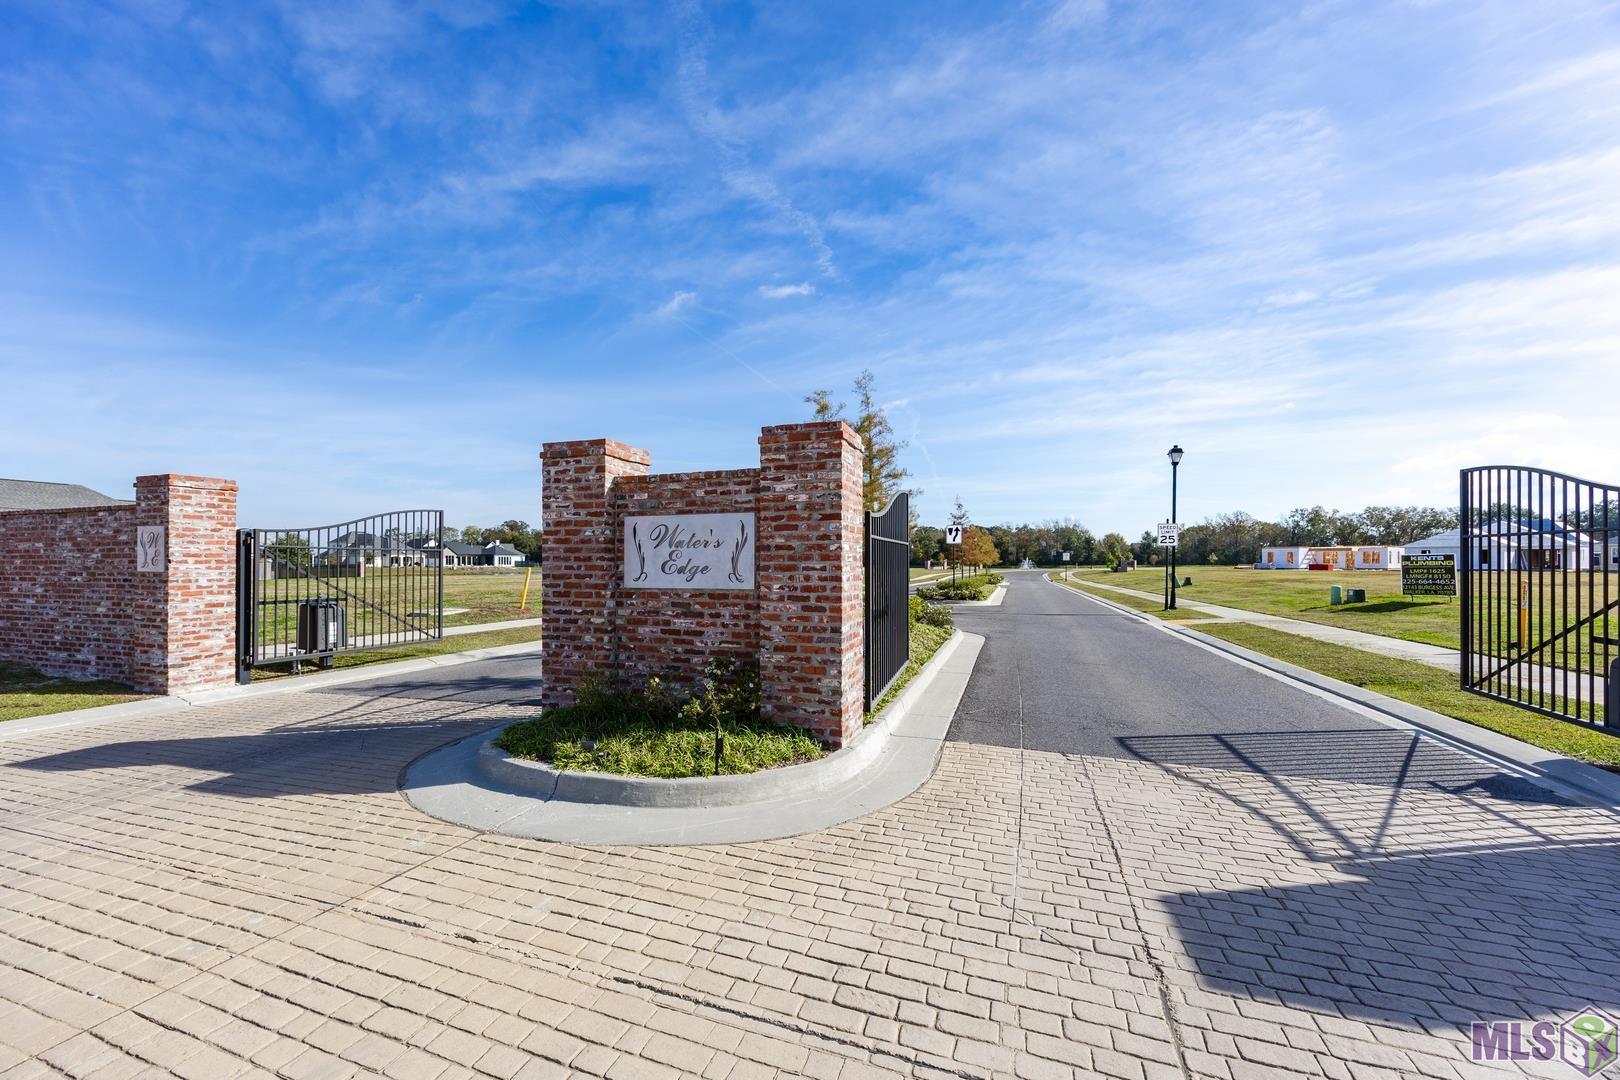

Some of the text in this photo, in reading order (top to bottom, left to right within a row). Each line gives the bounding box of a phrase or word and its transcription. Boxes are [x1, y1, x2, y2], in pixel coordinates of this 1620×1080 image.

[649, 523, 724, 549] Water's
[1160, 536, 1176, 544] 25
[660, 549, 712, 583] Edge
